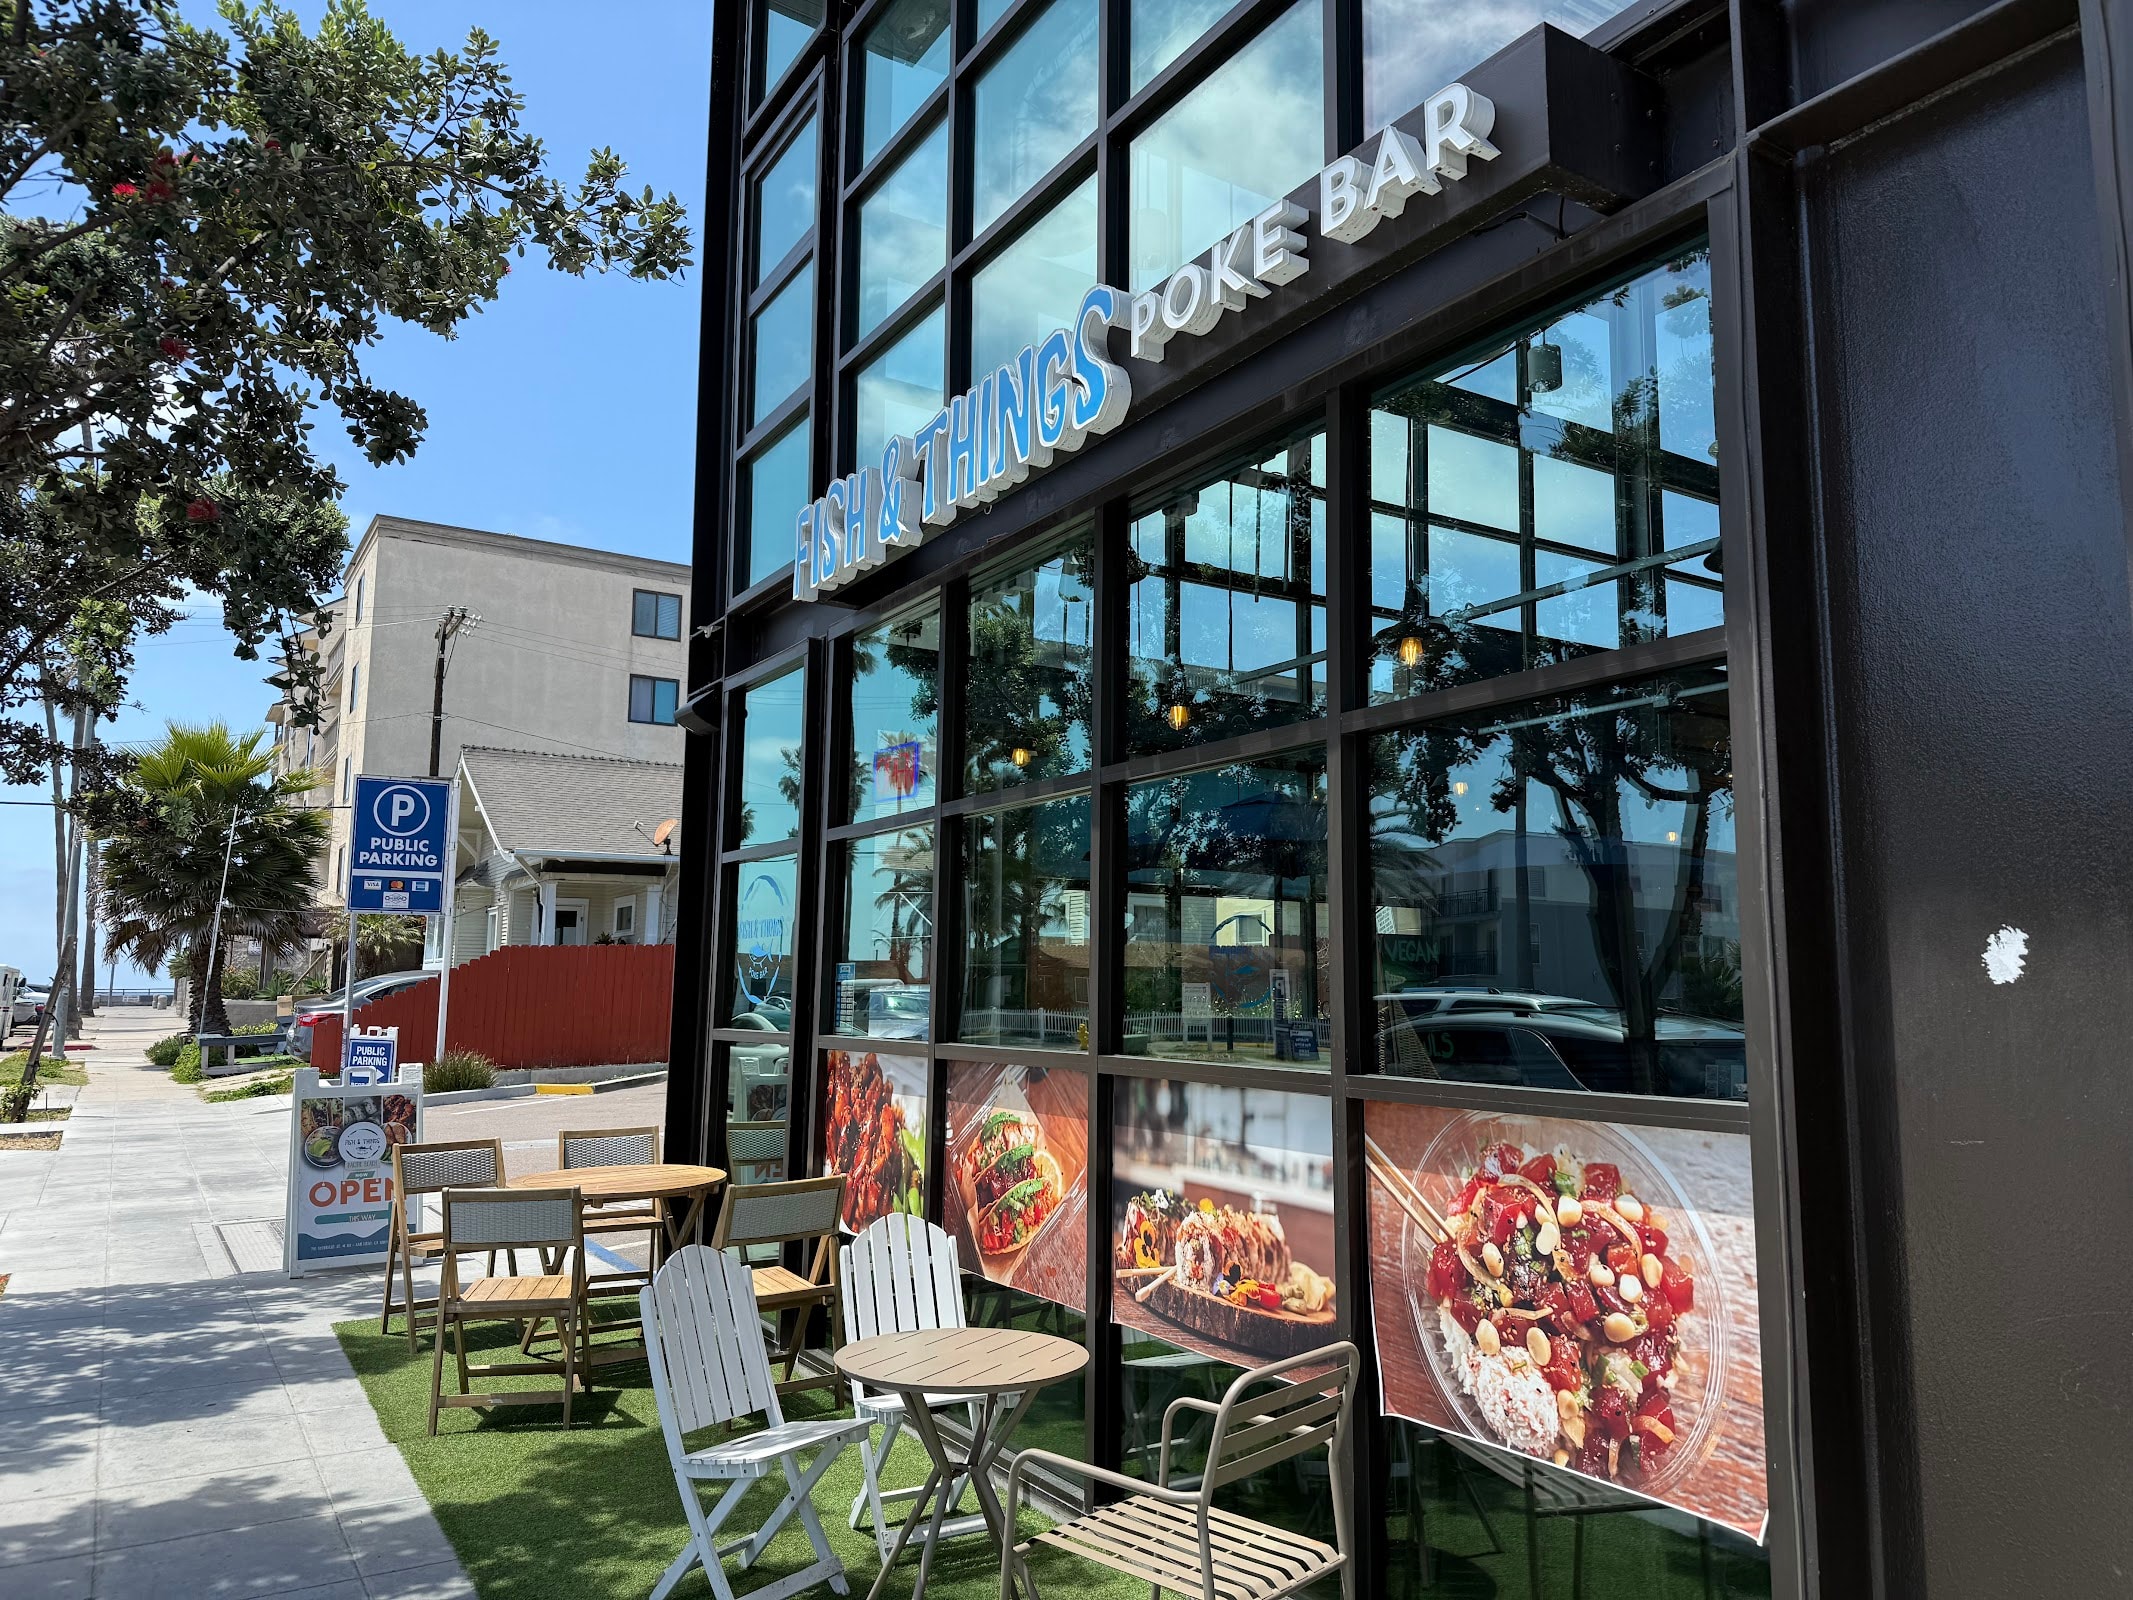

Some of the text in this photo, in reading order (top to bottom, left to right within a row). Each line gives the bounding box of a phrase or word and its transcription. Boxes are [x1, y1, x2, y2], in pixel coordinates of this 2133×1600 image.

[1131, 82, 1490, 361] POKE BAR
[793, 283, 1124, 601] FISH & THINGS
[391, 793, 415, 827] P
[370, 837, 430, 853] PUBLIC
[359, 851, 438, 867] PARKING
[1383, 938, 1441, 964] VEGAN
[356, 1045, 386, 1057] PUBLIC
[352, 1055, 388, 1066] PARKING
[349, 1213, 376, 1223] THIS WAY
